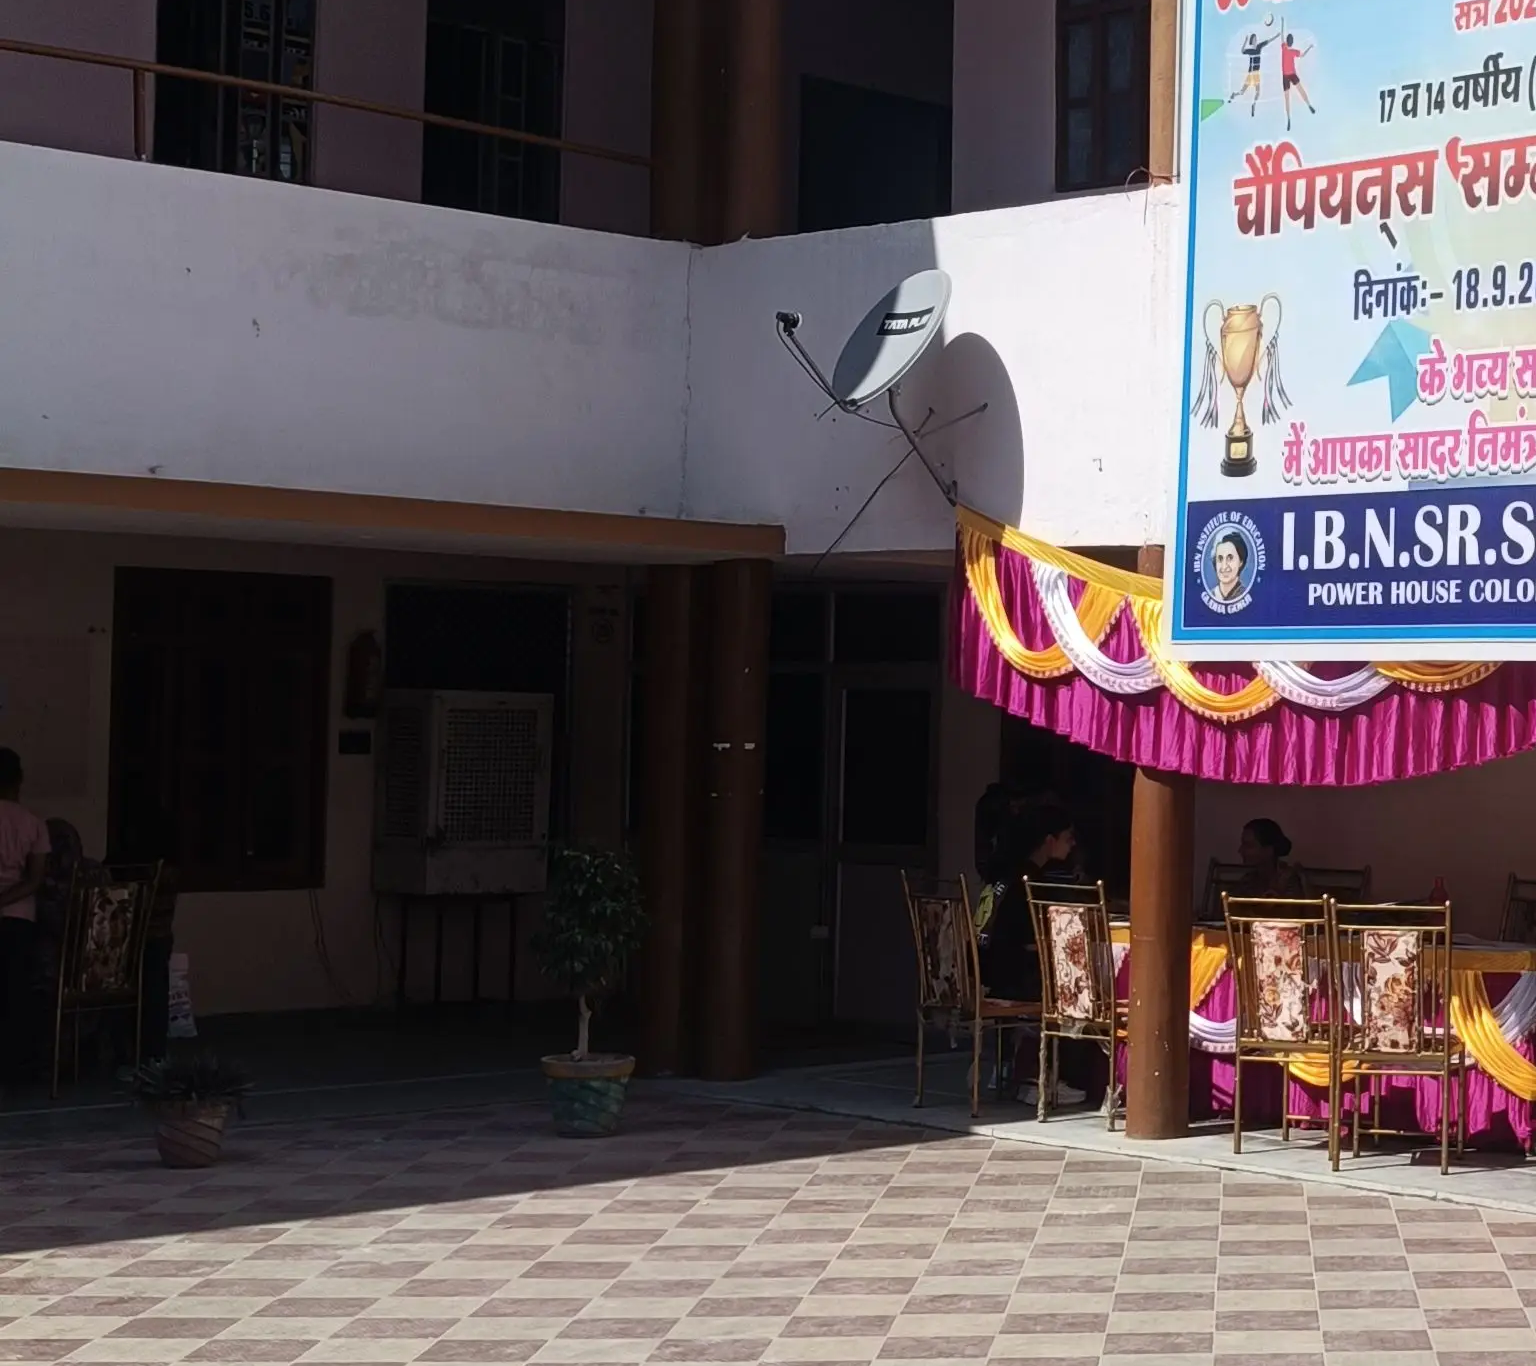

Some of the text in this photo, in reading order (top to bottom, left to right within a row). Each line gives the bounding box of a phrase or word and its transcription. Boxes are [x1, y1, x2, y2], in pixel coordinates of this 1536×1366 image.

[1379, 88, 1397, 123] 17
[1401, 83, 1421, 119] व
[1426, 81, 1446, 117] 14
[1452, 52, 1523, 110] वर्षीय
[884, 318, 909, 330] TATA
[1418, 339, 1446, 396] के
[1453, 351, 1511, 394] भव्य
[1283, 422, 1306, 477] में
[1309, 434, 1394, 476] आपका
[1398, 429, 1463, 475] सादर
[1230, 511, 1242, 522] OF
[1242, 515, 1267, 571] EDUCATION
[1308, 581, 1383, 606] POWER
[1391, 579, 1462, 605] HOUSE
